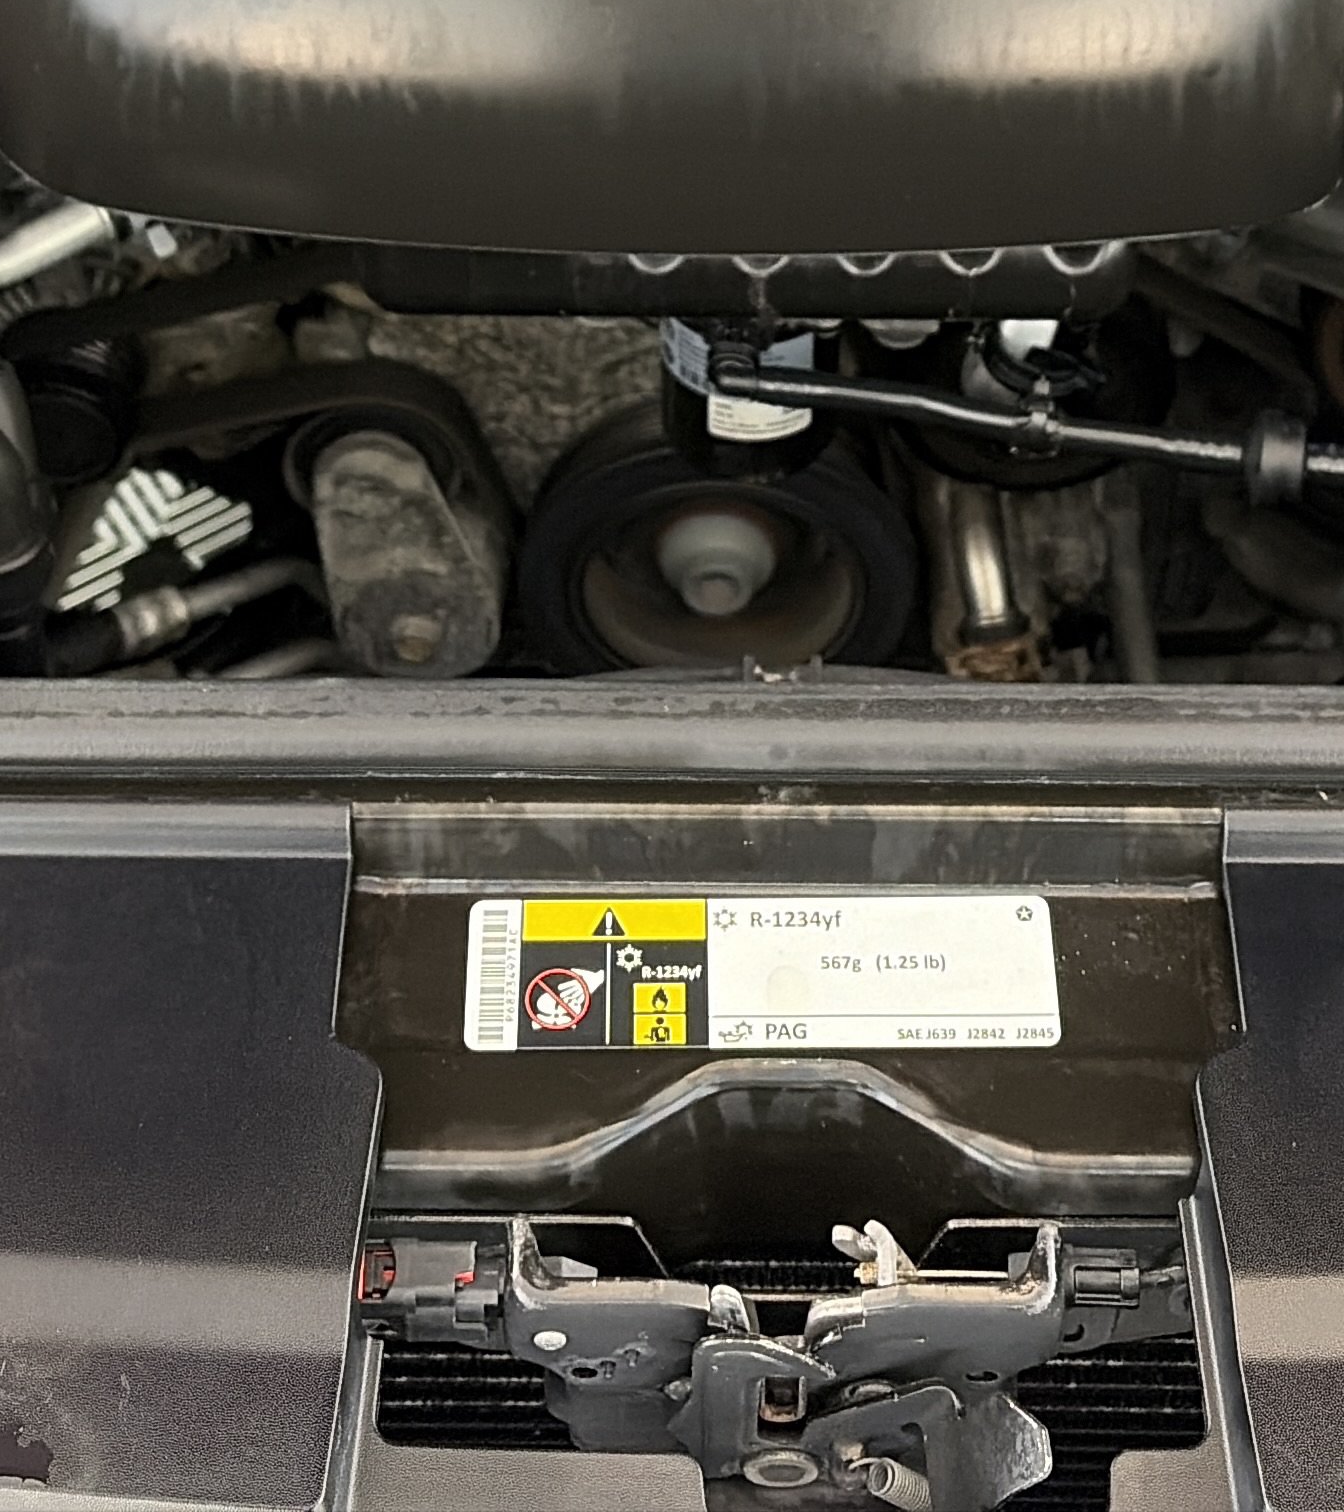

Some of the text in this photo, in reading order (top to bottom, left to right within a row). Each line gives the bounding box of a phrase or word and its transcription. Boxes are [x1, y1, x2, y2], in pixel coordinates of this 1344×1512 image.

[750, 910, 842, 932] R-1234yf
[820, 955, 861, 973] 567g
[875, 954, 947, 972] (1.25 lb)
[641, 964, 703, 981] R-1234yf
[765, 1024, 808, 1040] PAG
[897, 1027, 1055, 1040] SAE J639 J2842 J2845
